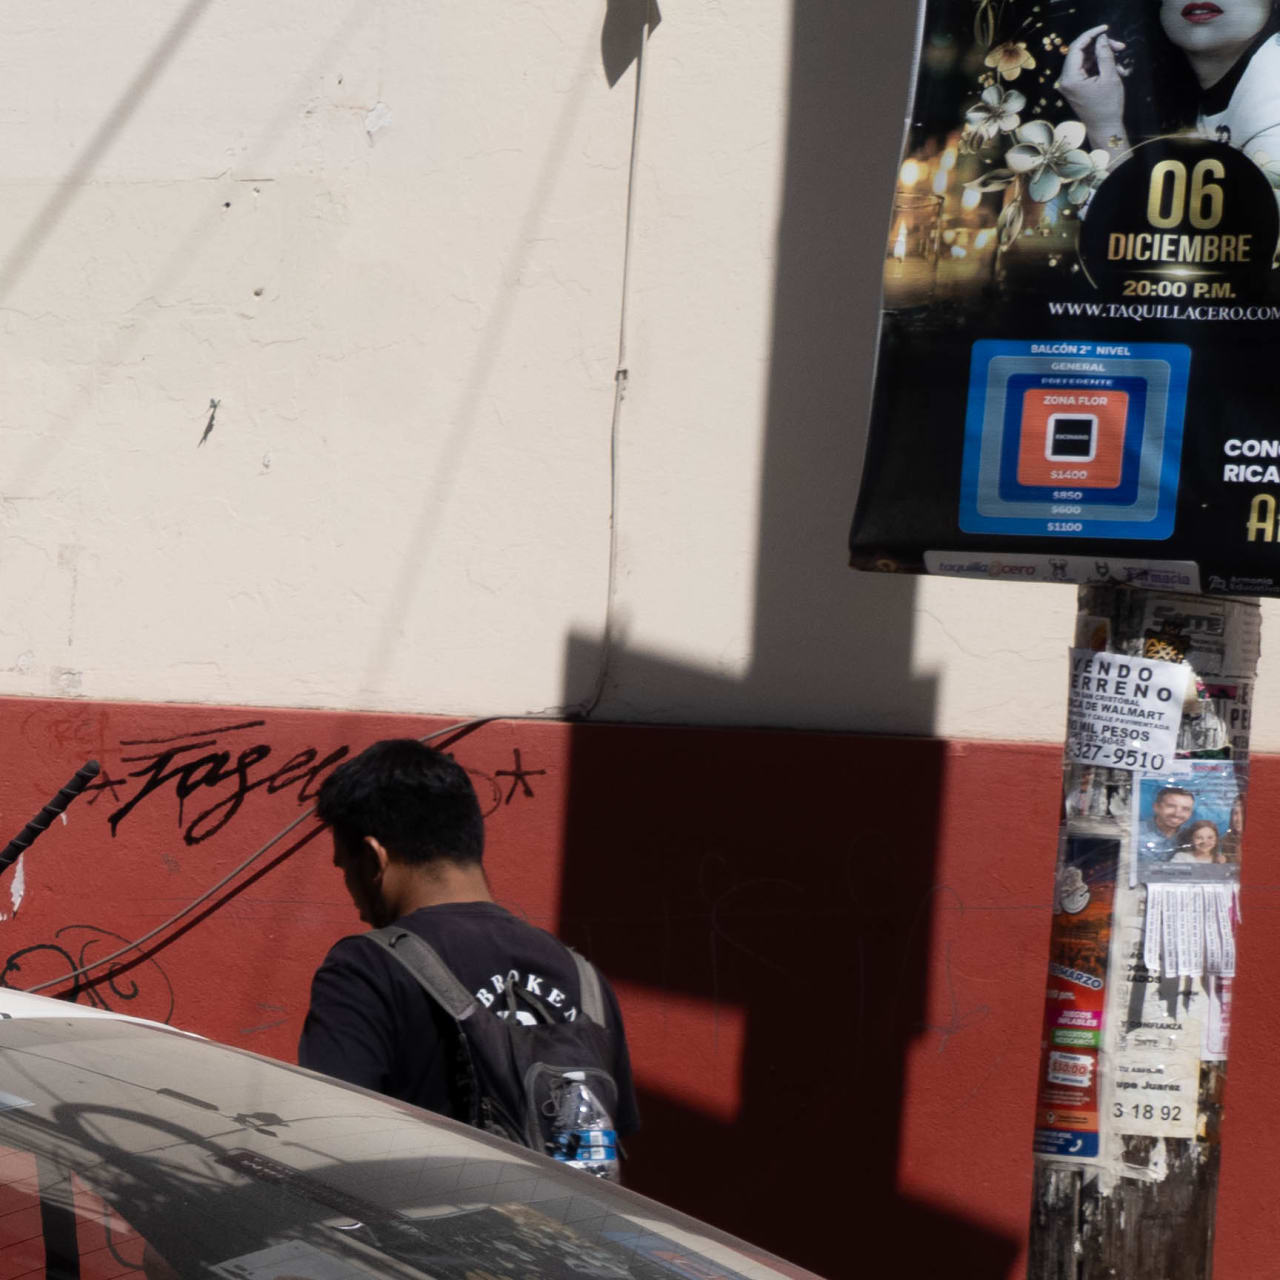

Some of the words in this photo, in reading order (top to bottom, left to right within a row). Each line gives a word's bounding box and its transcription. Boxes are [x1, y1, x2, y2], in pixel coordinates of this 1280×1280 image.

[1147, 158, 1225, 229] 06
[1107, 233, 1252, 262] DICIEMBRE
[1122, 281, 1186, 297] 20:00
[1193, 282, 1236, 298] P.M.
[1031, 343, 1077, 354] BALCÓN
[1096, 346, 1130, 356] NIVEL
[1051, 362, 1106, 371] GENERAL
[1043, 395, 1075, 405] ZONA
[1078, 396, 1108, 406] FLOR
[1047, 522, 1083, 531] $1100
[1073, 658, 1152, 682] VENDO
[1085, 701, 1098, 711] DE
[1101, 703, 1165, 721] WALMART
[1081, 722, 1096, 733] MIL
[1101, 725, 1150, 741] PESOS
[1132, 1103, 1154, 1119] 18
[1160, 1105, 1182, 1121] 92
